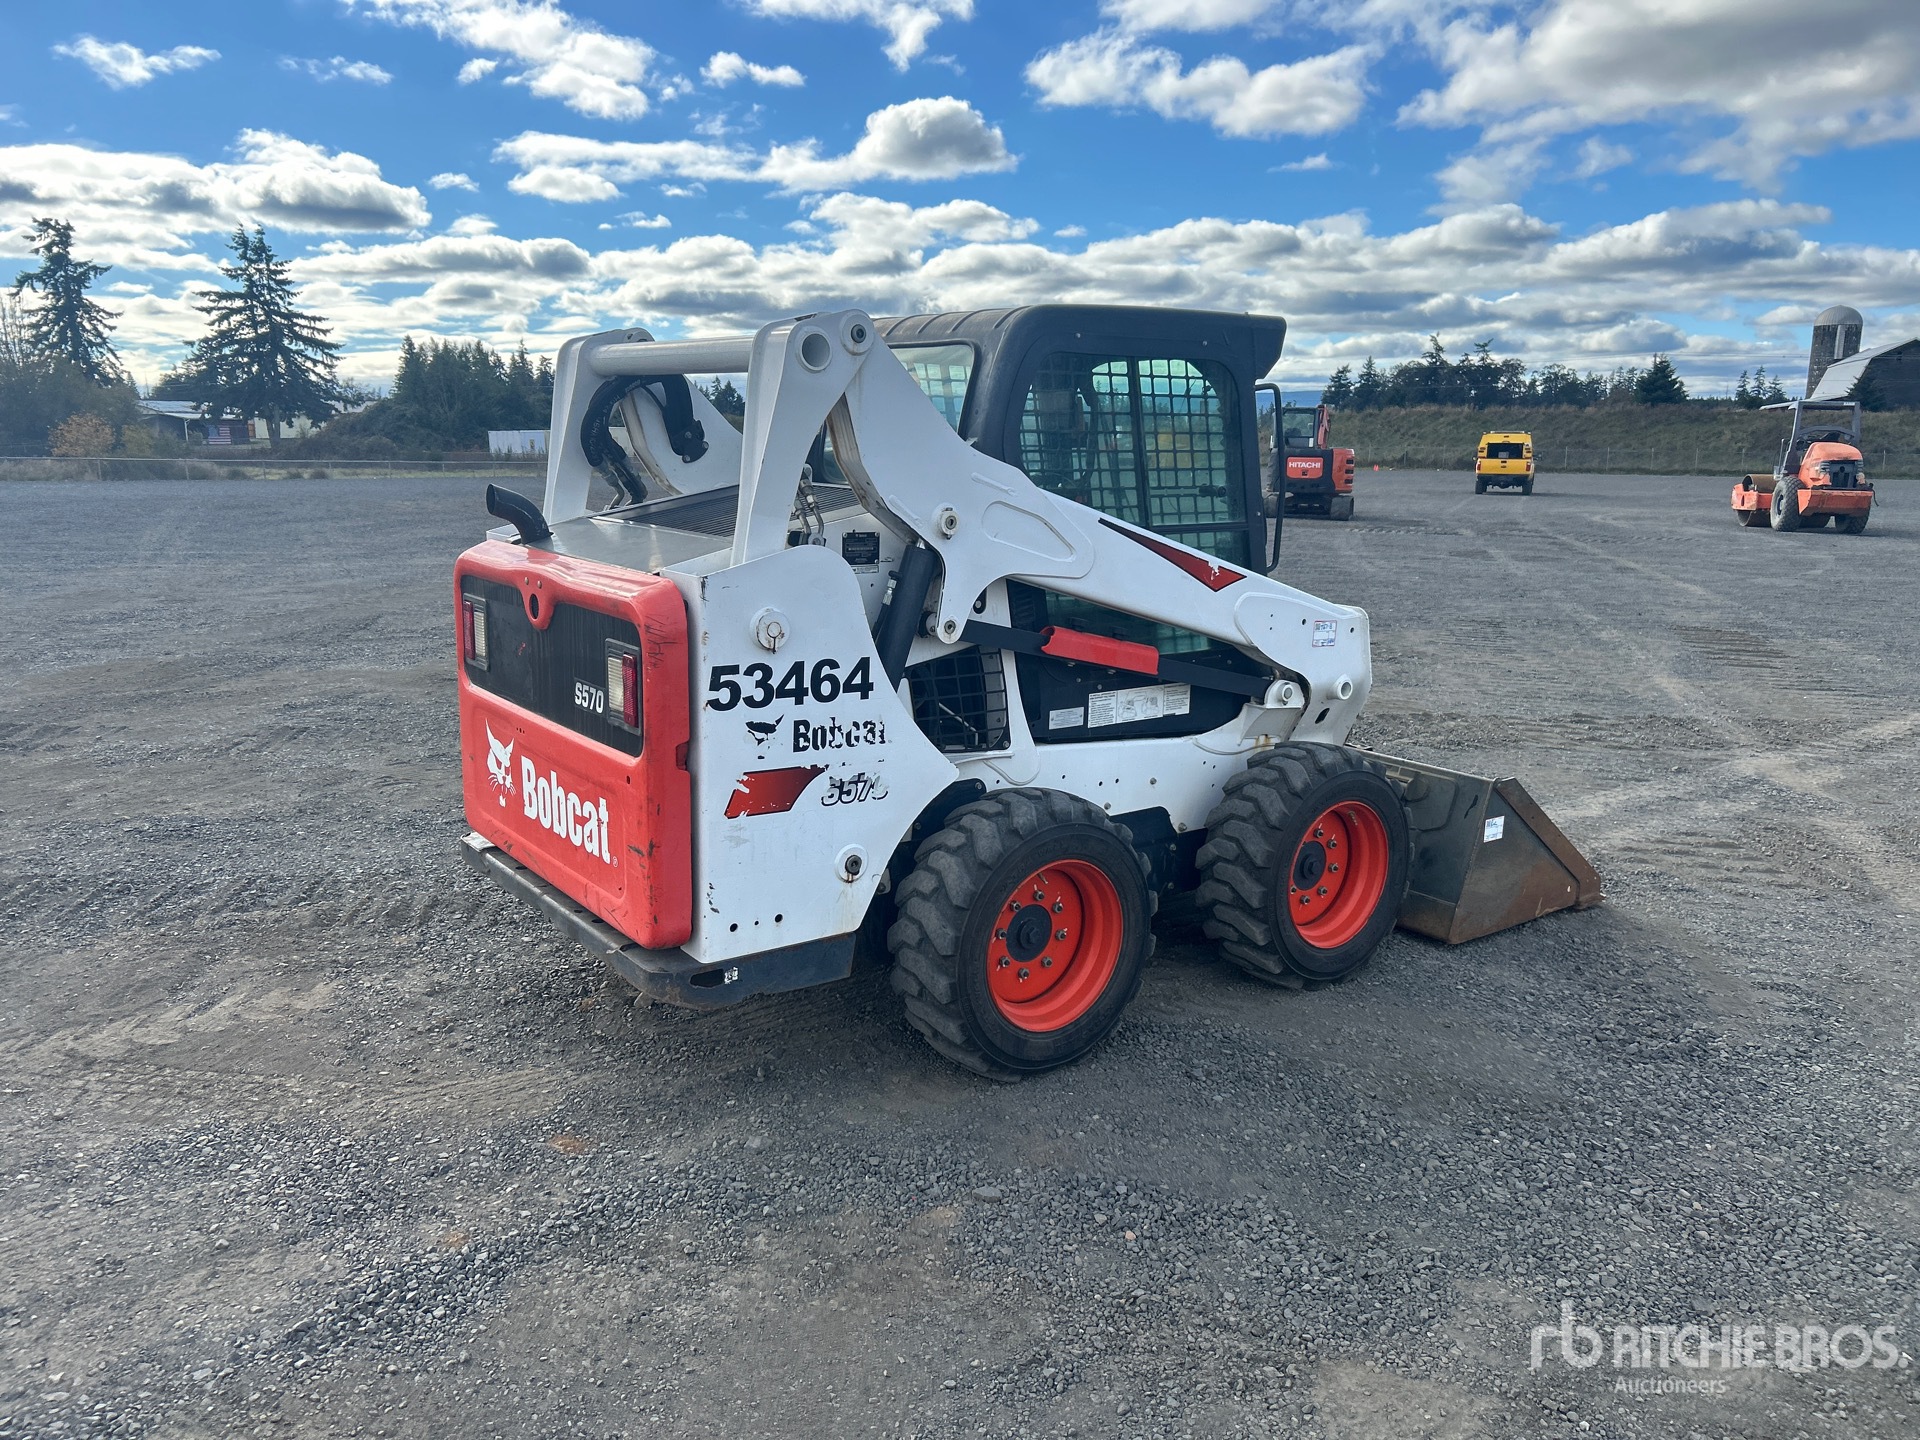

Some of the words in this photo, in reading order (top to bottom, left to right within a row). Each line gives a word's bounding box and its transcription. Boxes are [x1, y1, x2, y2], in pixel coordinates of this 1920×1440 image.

[1288, 461, 1321, 469] HITACHI
[574, 681, 605, 714] S570
[707, 656, 875, 713] 53464
[520, 754, 612, 865] Bobcat
